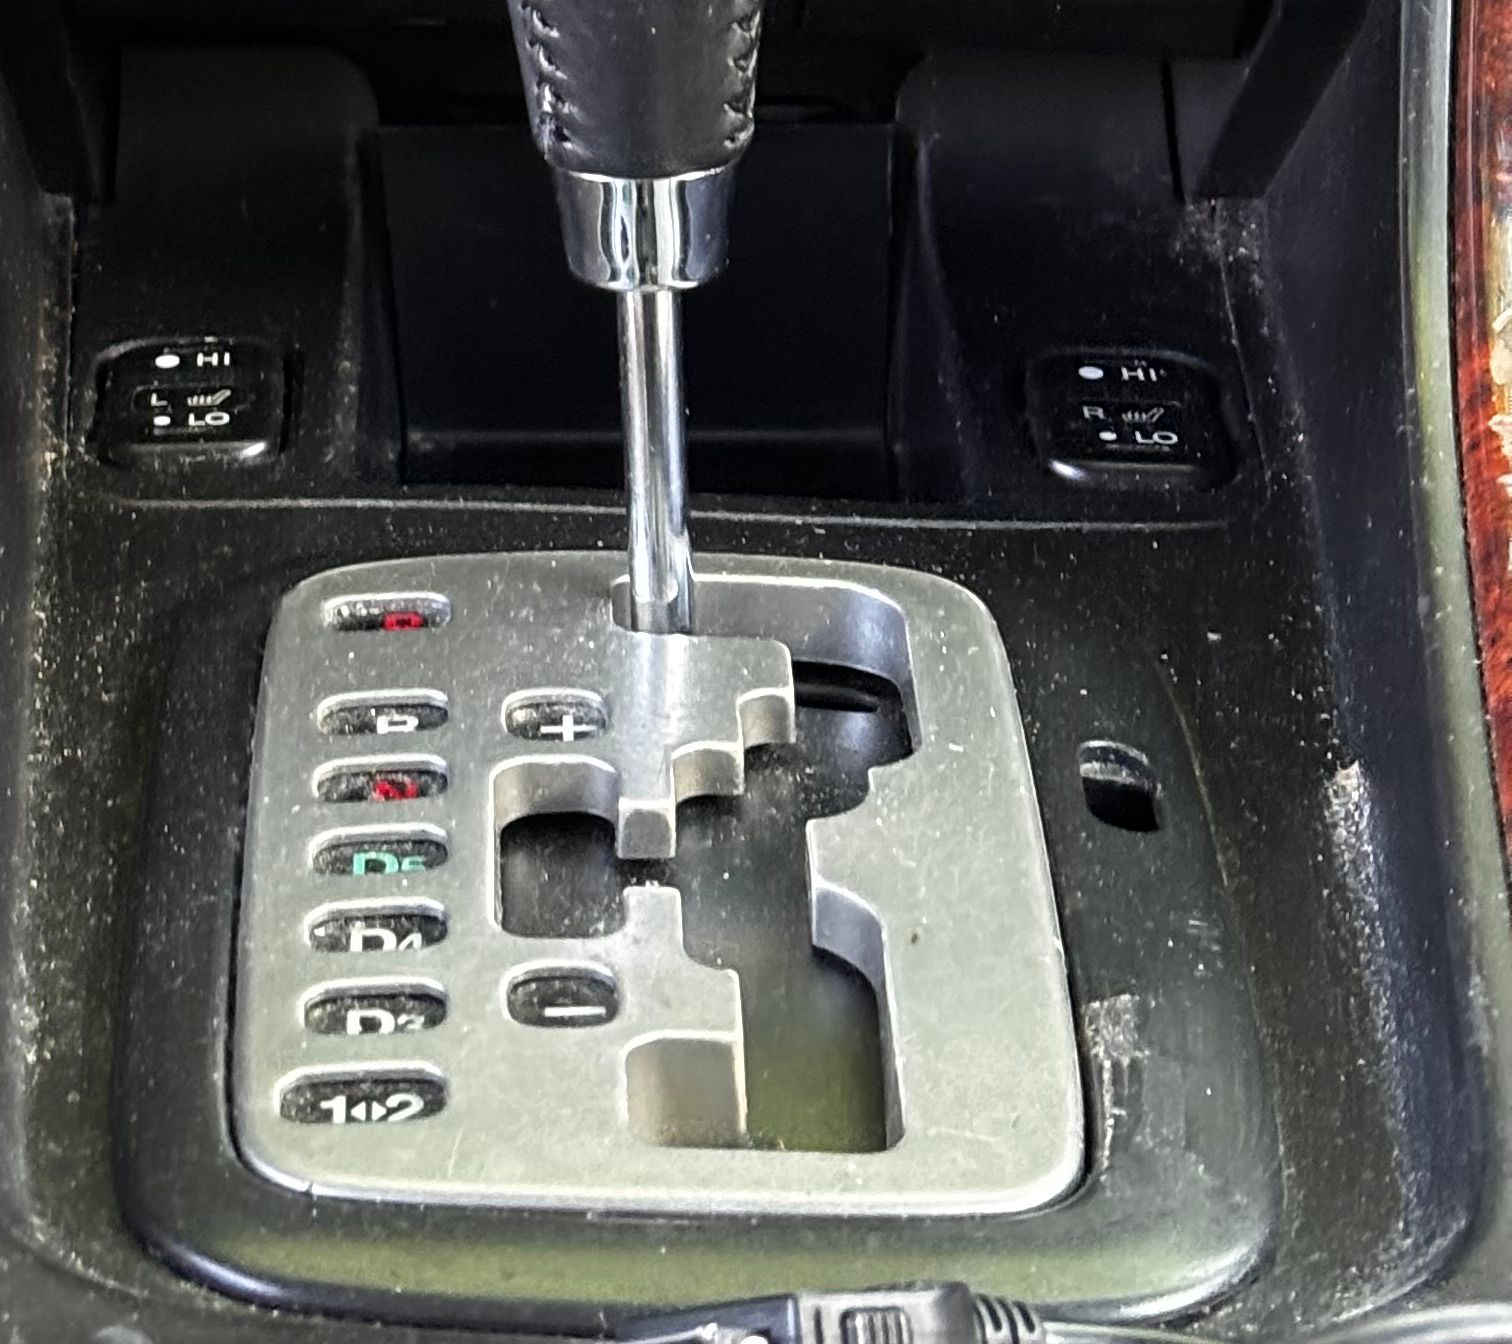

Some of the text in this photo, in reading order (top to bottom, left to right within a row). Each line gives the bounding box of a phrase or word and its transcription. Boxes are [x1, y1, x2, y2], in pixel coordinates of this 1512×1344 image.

[196, 352, 230, 367] HI
[1121, 367, 1157, 382] HI
[188, 411, 230, 427] LO
[1134, 430, 1179, 445] LO
